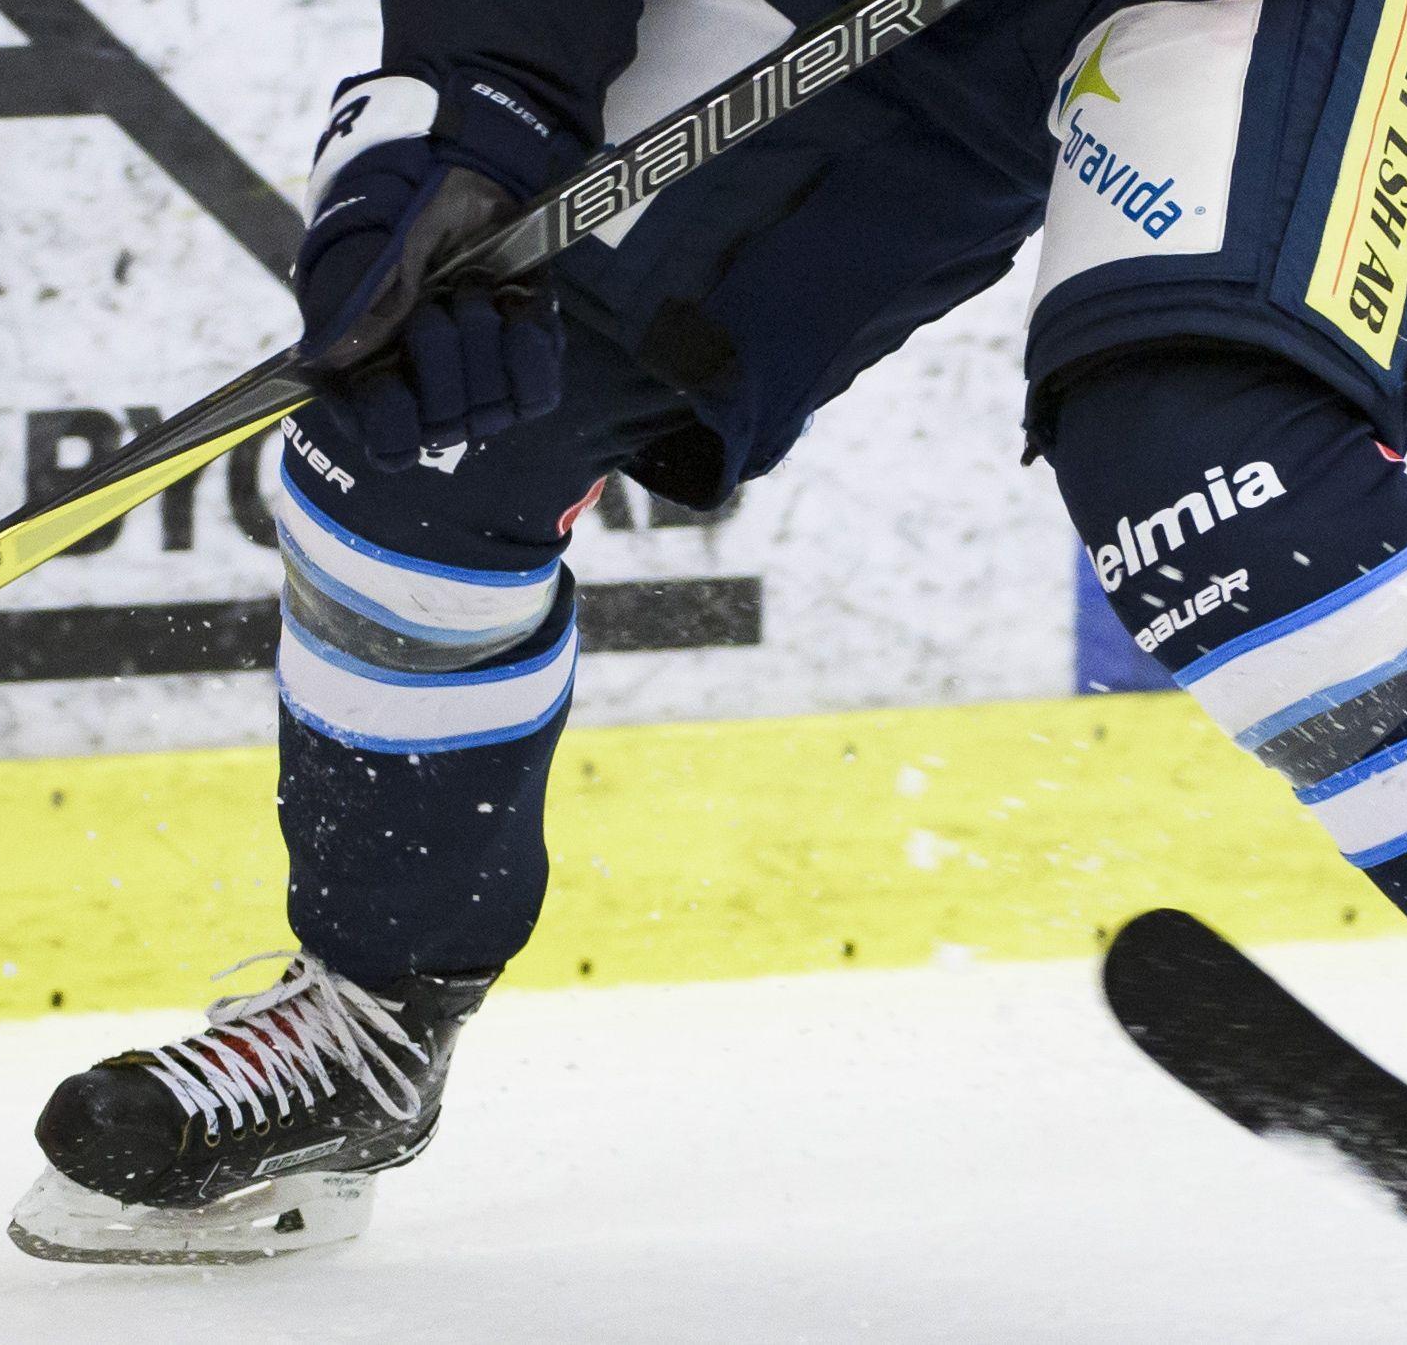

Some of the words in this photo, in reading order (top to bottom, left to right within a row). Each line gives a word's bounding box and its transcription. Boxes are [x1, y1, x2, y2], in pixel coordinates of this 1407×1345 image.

[1063, 109, 1182, 241] bravida
[1348, 251, 1396, 335] AB
[1086, 460, 1288, 594] elmia
